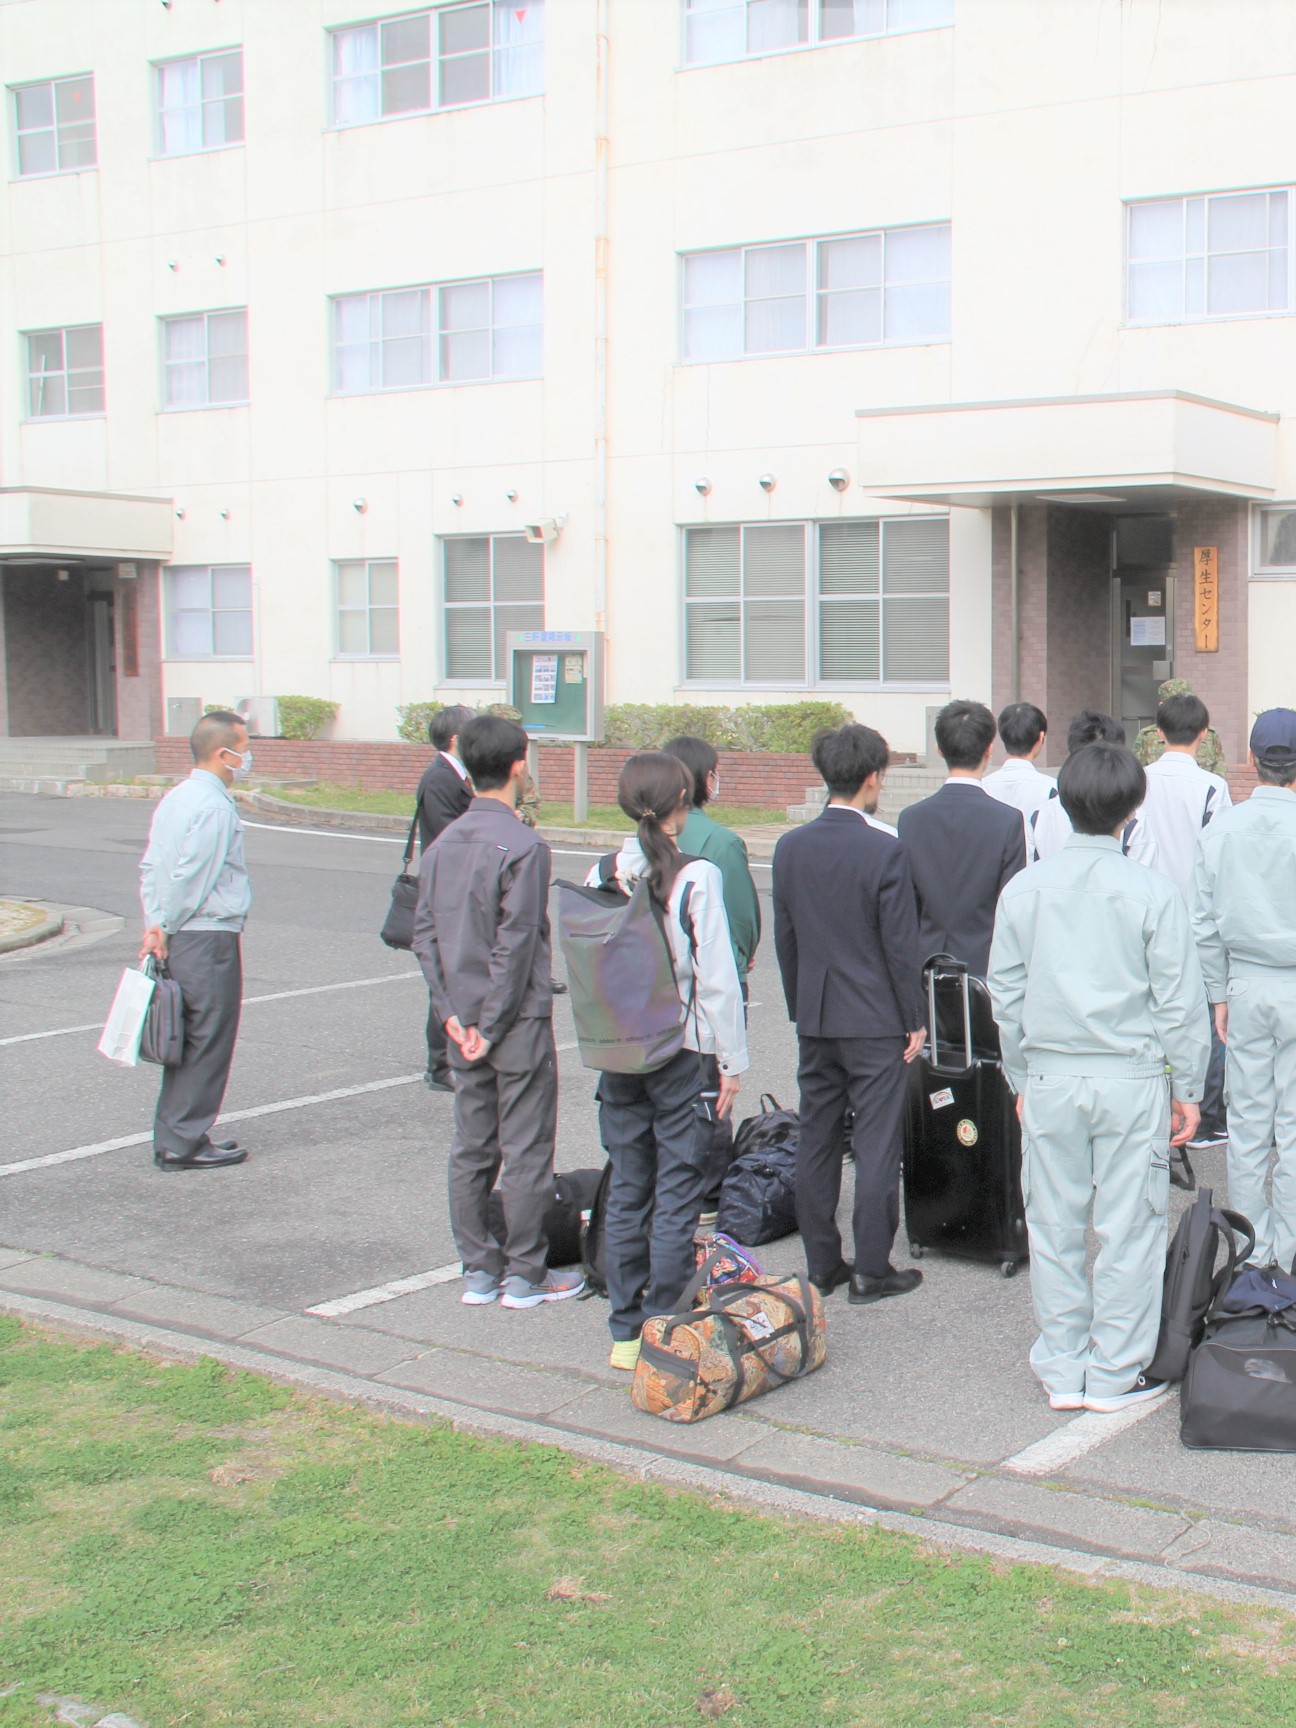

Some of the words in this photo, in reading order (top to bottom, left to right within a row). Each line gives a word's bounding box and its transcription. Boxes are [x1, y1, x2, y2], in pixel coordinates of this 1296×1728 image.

[1199, 549, 1213, 649] 厚生センター
